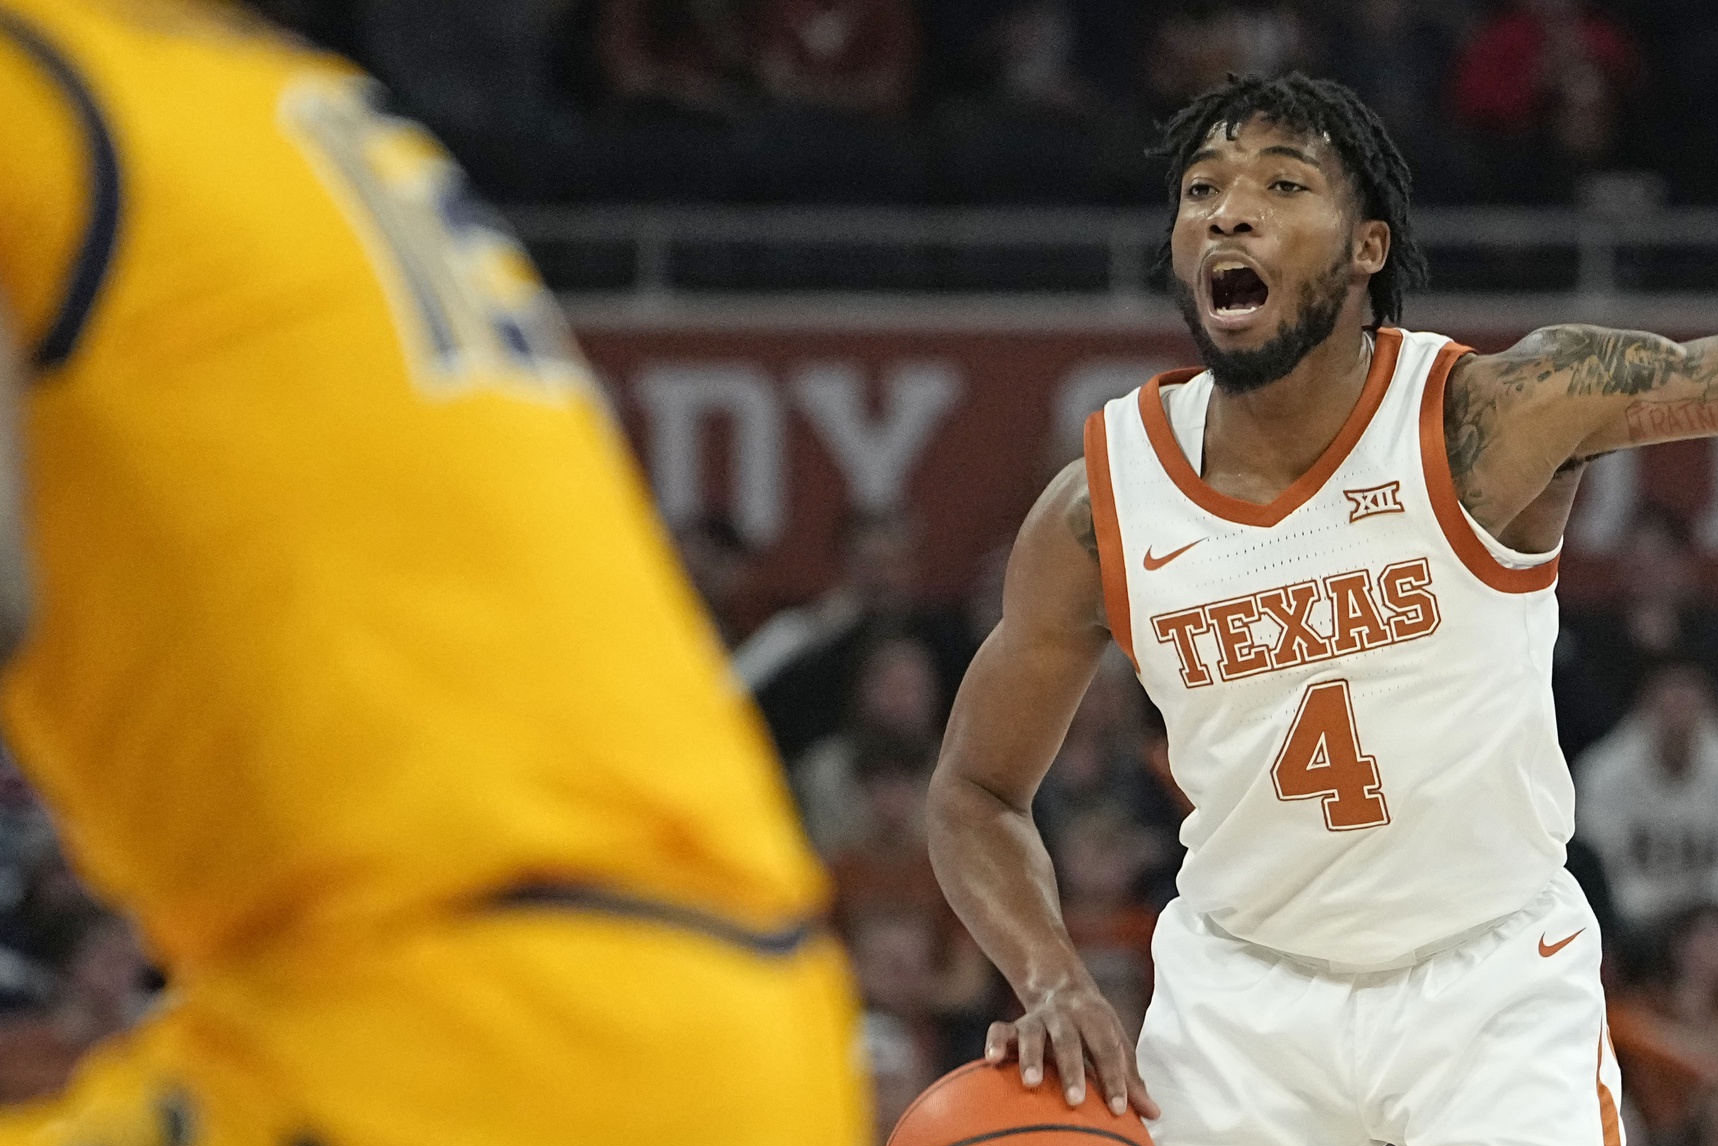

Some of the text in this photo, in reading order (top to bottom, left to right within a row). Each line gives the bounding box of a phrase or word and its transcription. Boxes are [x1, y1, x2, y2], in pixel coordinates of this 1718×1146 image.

[636, 362, 966, 545] DY
[1343, 480, 1405, 523] XII
[1150, 557, 1442, 689] TEXAS
[1270, 678, 1391, 832] 4
